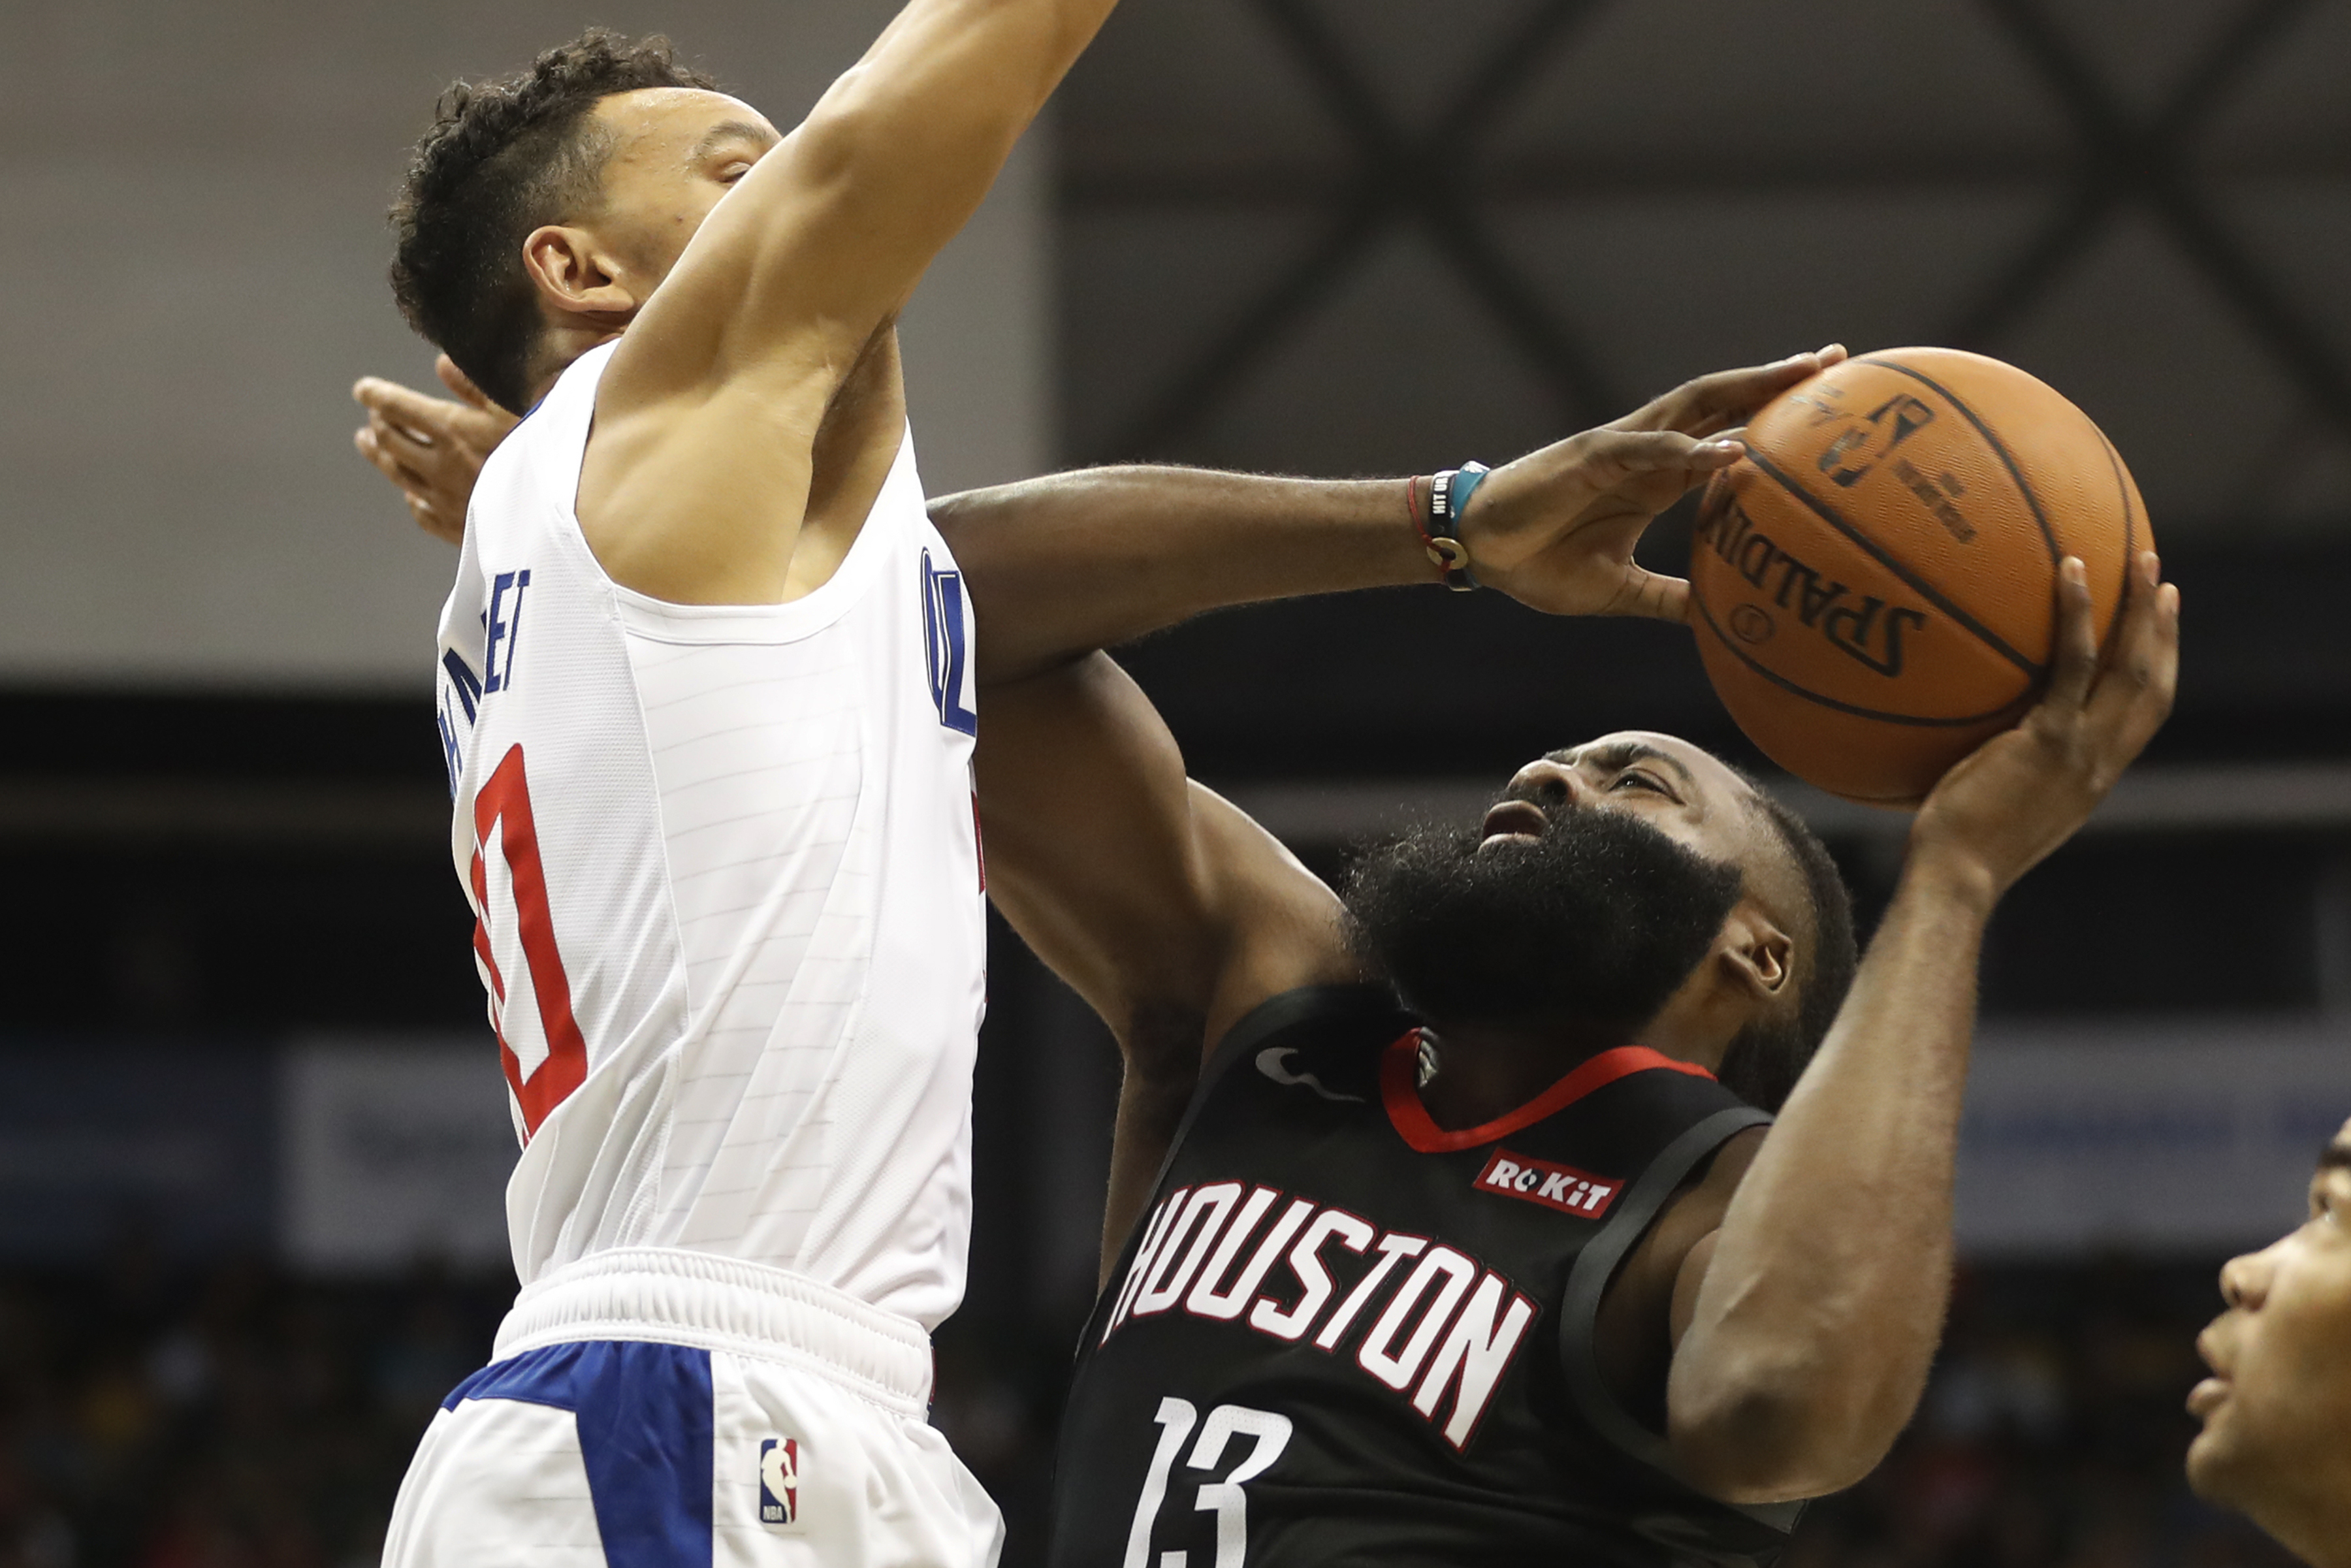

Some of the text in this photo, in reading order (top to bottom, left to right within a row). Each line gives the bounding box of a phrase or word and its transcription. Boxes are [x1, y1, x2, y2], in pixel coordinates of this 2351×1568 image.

[1433, 494, 1447, 514] HIT
[1703, 496, 1928, 678] SPALDIN
[1097, 1179, 1539, 1454] HOUSTON
[763, 1505, 783, 1521] NBA
[1123, 1396, 1293, 1568] 13
